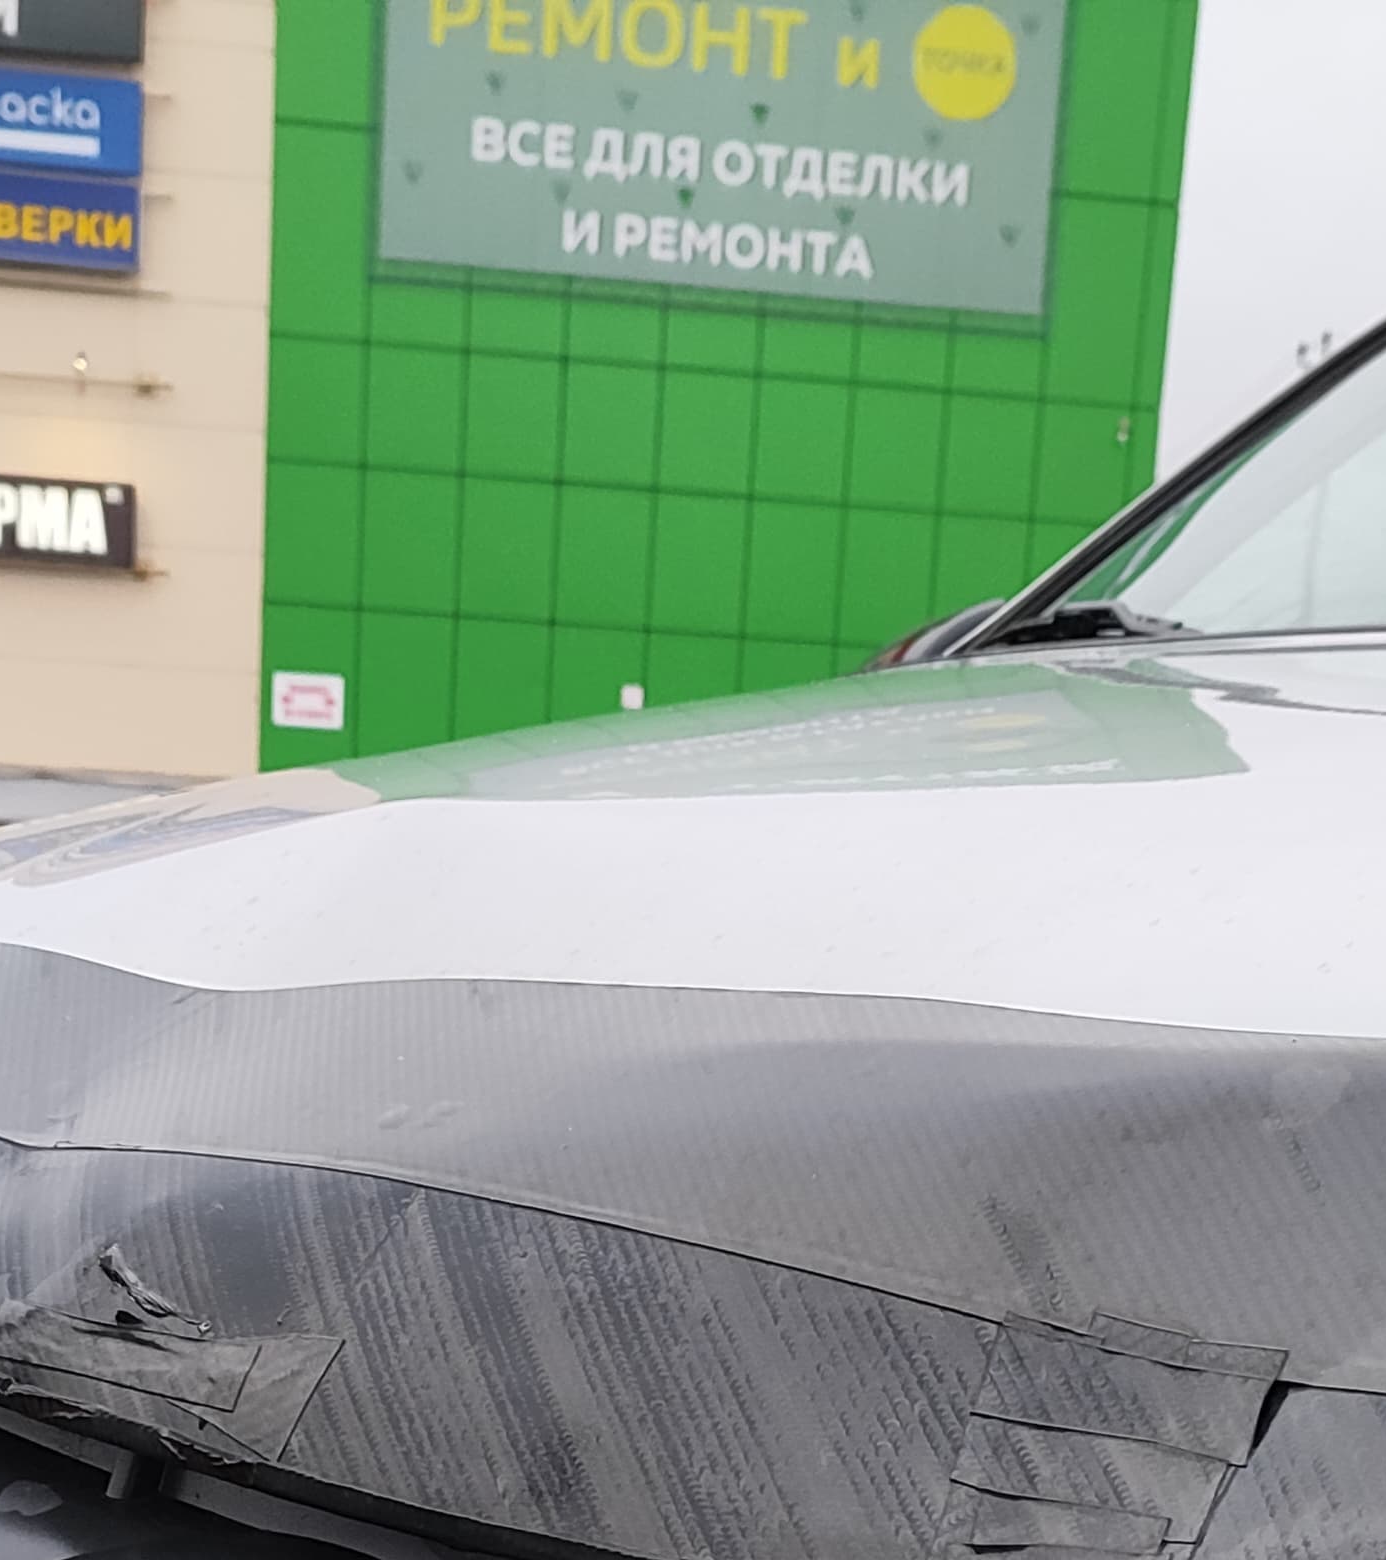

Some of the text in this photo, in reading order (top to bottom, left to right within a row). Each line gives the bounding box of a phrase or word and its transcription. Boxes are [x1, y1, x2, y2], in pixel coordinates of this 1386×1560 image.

[429, 0, 808, 80] РЕМОНТ
[471, 116, 971, 206] ВСЕ ДЛЯ ОТДЕЛКИ
[561, 210, 873, 280] И РЕМОНТА
